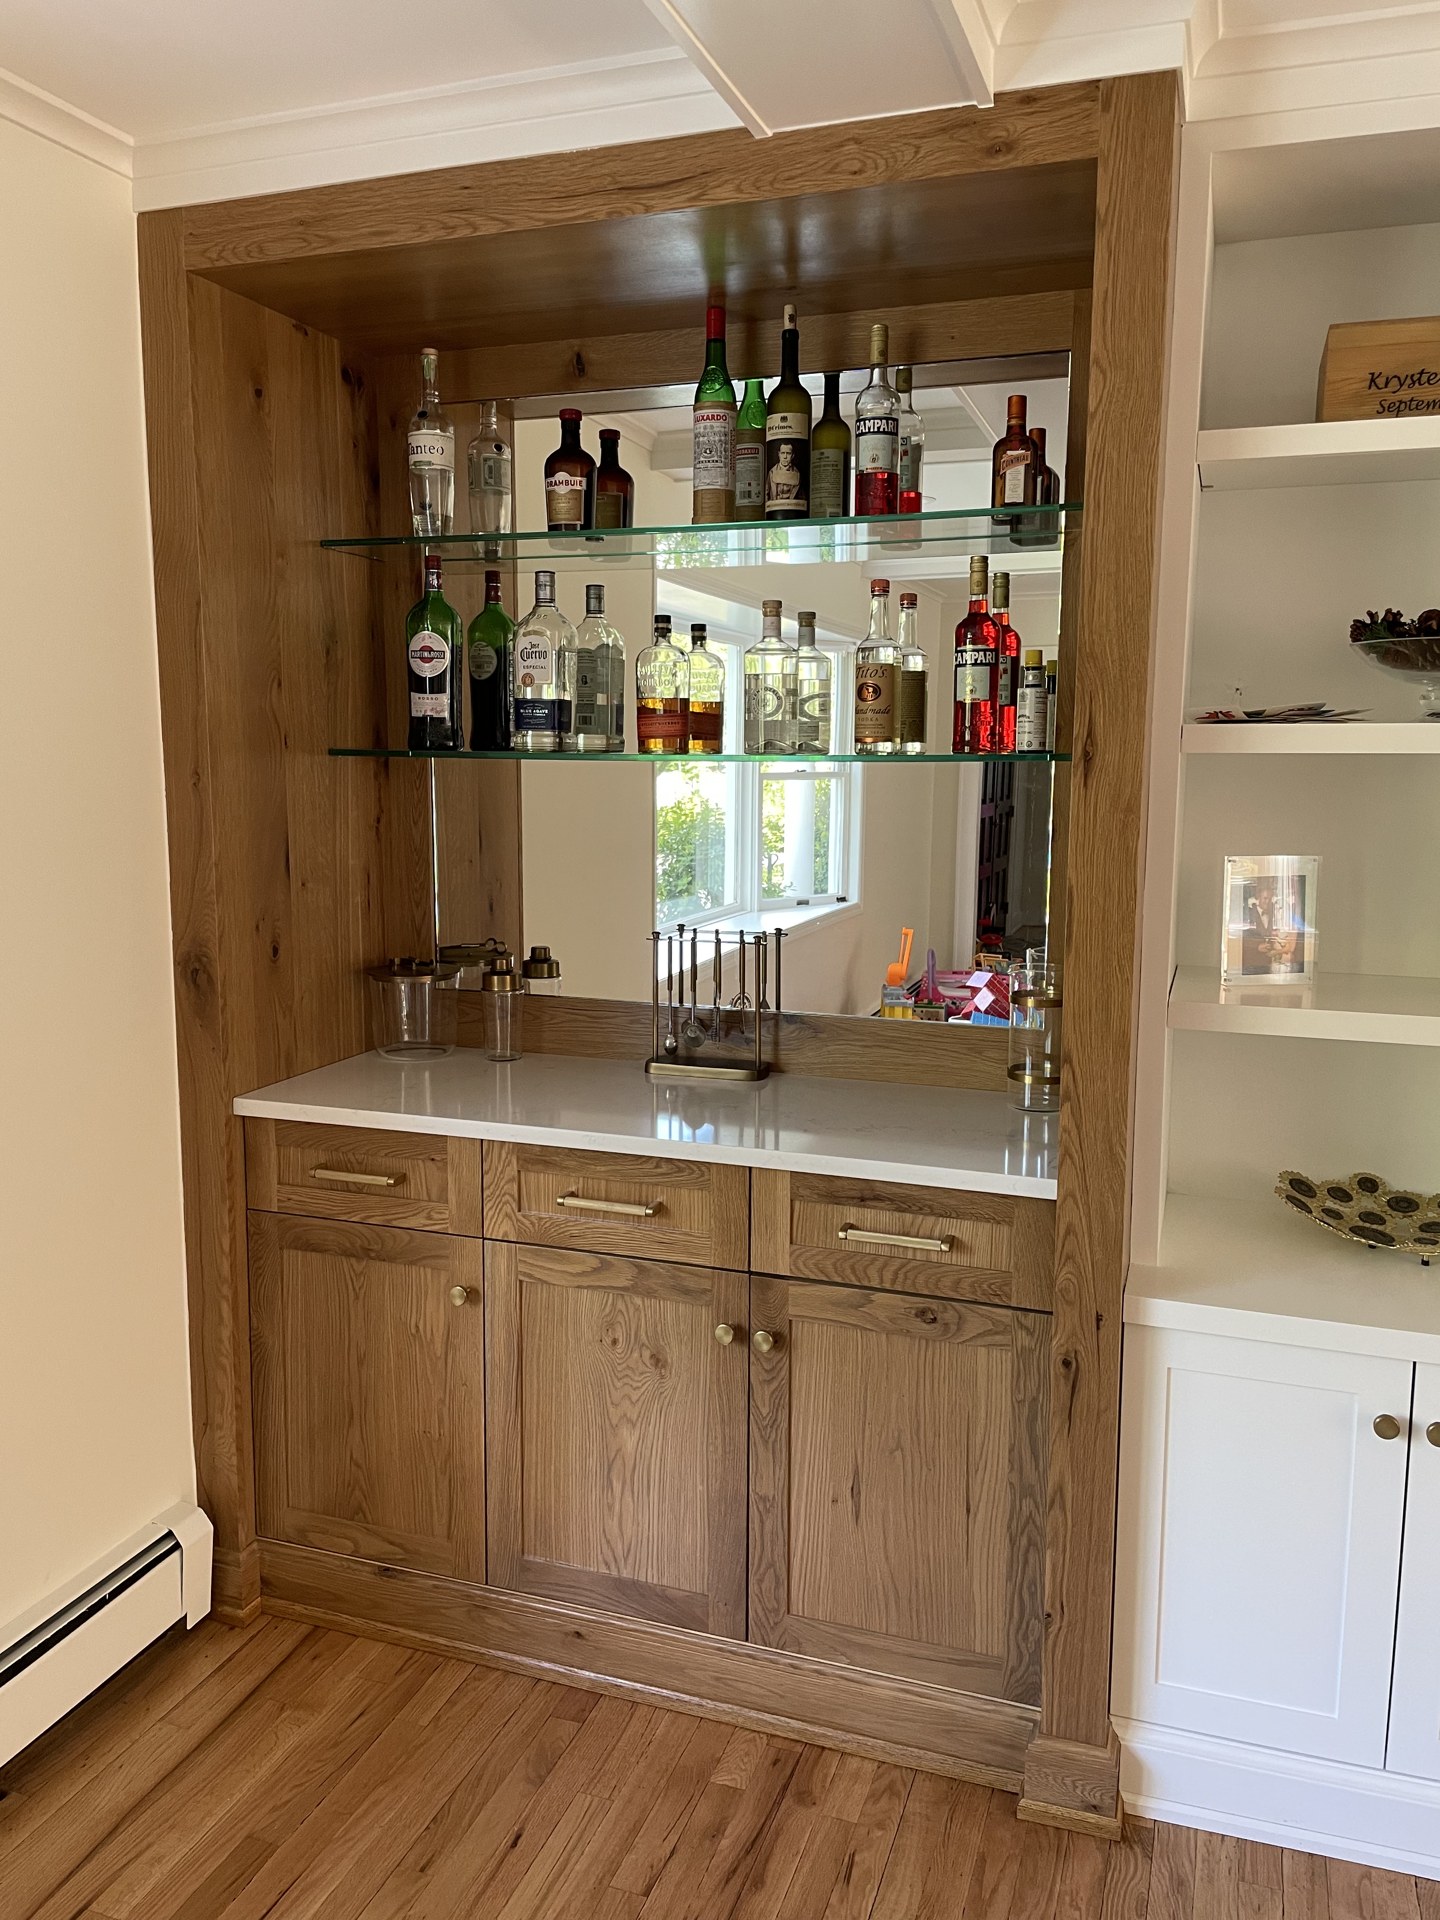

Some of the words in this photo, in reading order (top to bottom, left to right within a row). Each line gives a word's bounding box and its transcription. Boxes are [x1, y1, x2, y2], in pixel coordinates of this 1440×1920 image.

[1368, 368, 1440, 394] Kryste
[856, 419, 897, 434] CAMPARI
[546, 480, 583, 489] DRAMBUIE
[520, 647, 548, 662] Cuervo
[954, 651, 996, 665] CAMPARI
